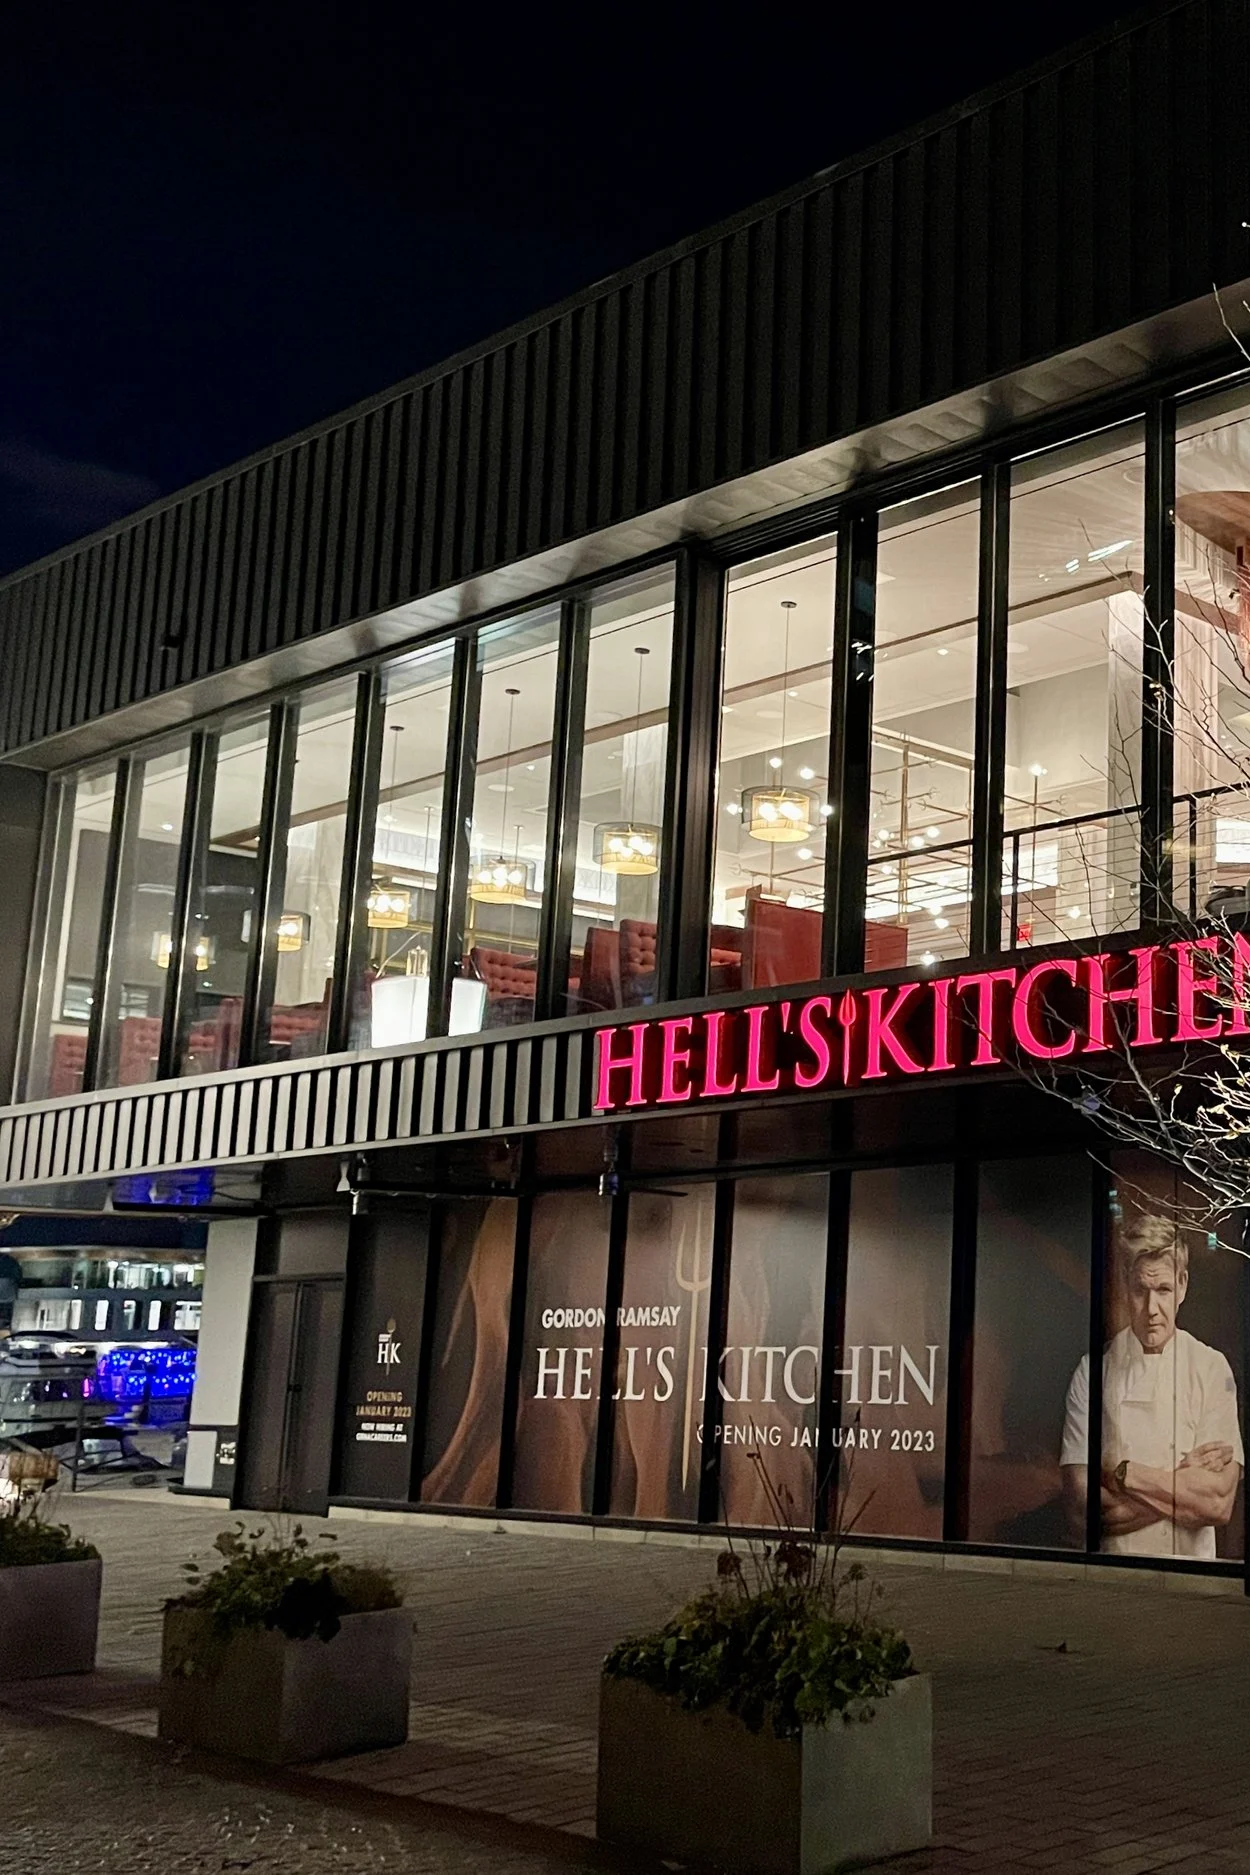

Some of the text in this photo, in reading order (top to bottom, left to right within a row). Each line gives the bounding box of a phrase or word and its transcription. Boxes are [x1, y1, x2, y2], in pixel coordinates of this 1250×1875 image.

[594, 996, 834, 1110] HELL'S
[541, 1305, 681, 1329] GORDON RAMSAY
[533, 1346, 675, 1402] HEL'S
[366, 1391, 403, 1402] OPENING
[355, 1405, 391, 1416] JANUARY
[790, 1427, 882, 1450] JAUARY
[890, 1429, 935, 1452] 2023
